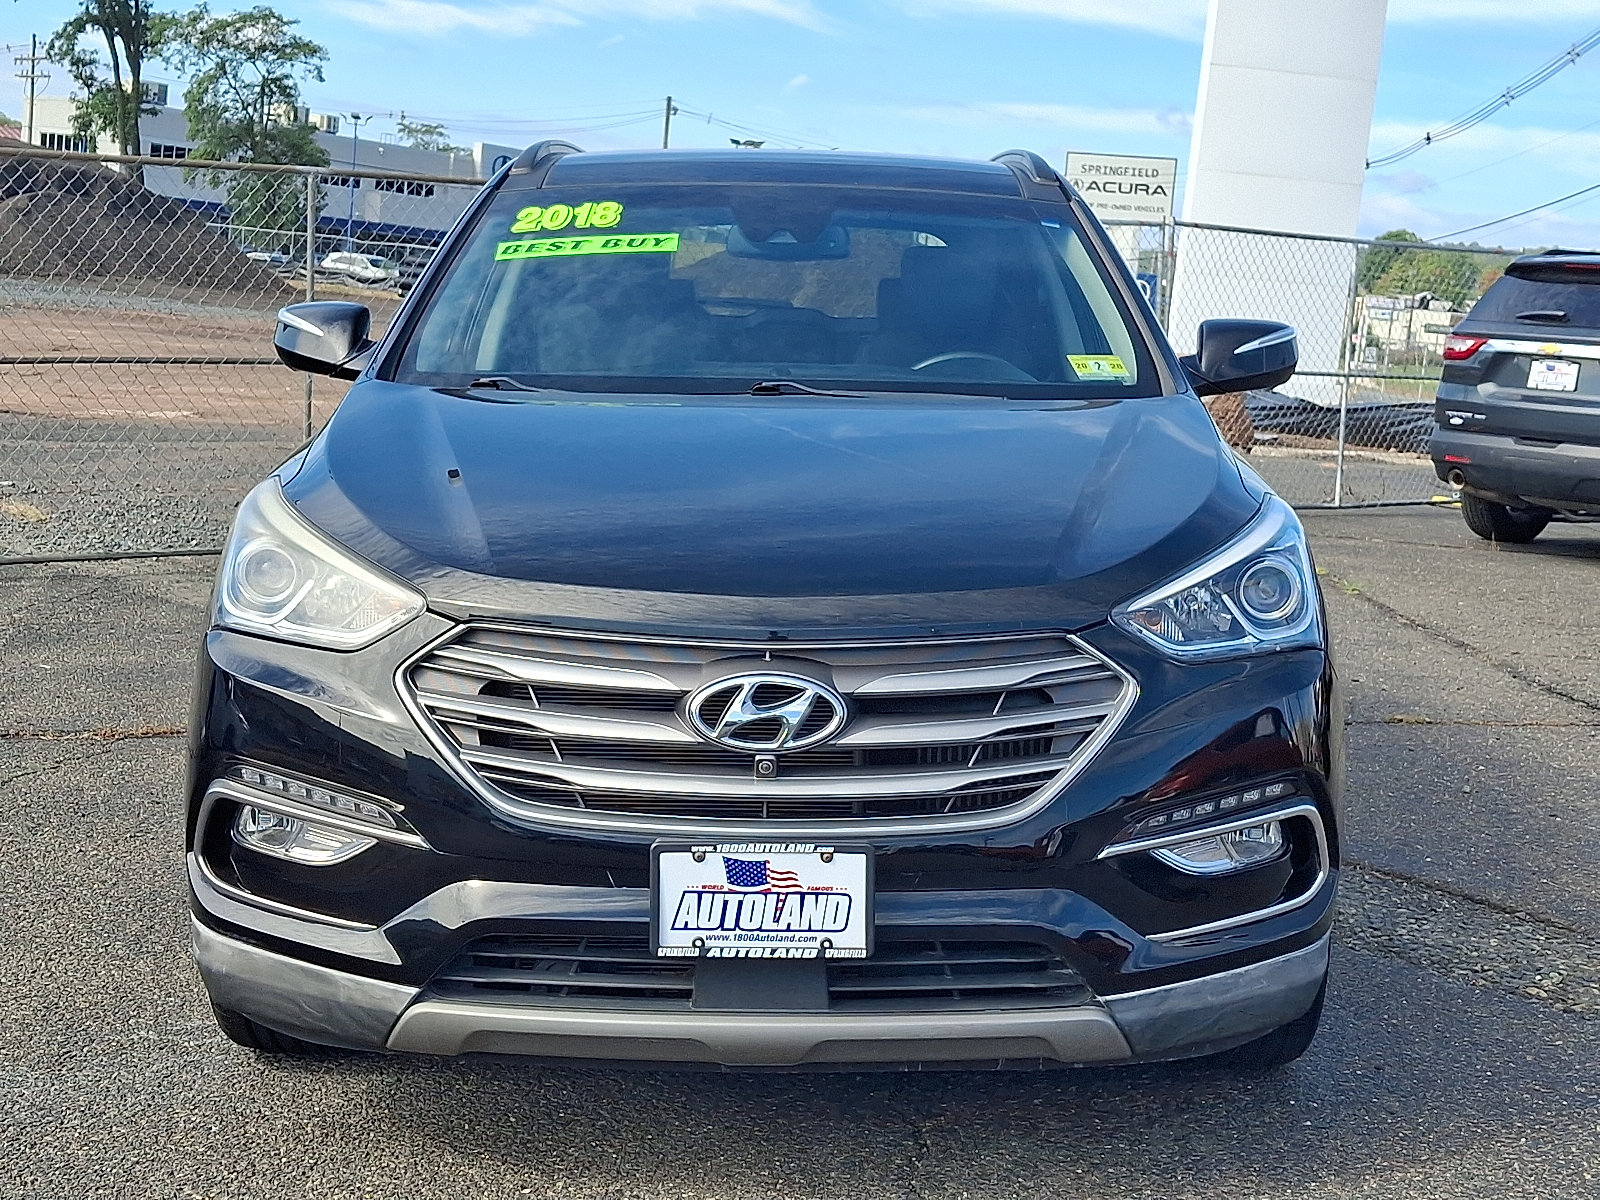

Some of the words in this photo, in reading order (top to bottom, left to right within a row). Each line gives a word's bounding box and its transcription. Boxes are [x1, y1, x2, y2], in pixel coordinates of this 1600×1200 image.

[1080, 164, 1160, 178] SPRINGFIELD
[1085, 180, 1168, 197] ACURA
[511, 201, 624, 234] 2018
[500, 239, 590, 255] BEST
[600, 236, 674, 249] BUY
[670, 890, 852, 933] AUTOLAND
[705, 933, 818, 943] www.1800Autoland.com
[706, 947, 820, 959] AUTOLAND
